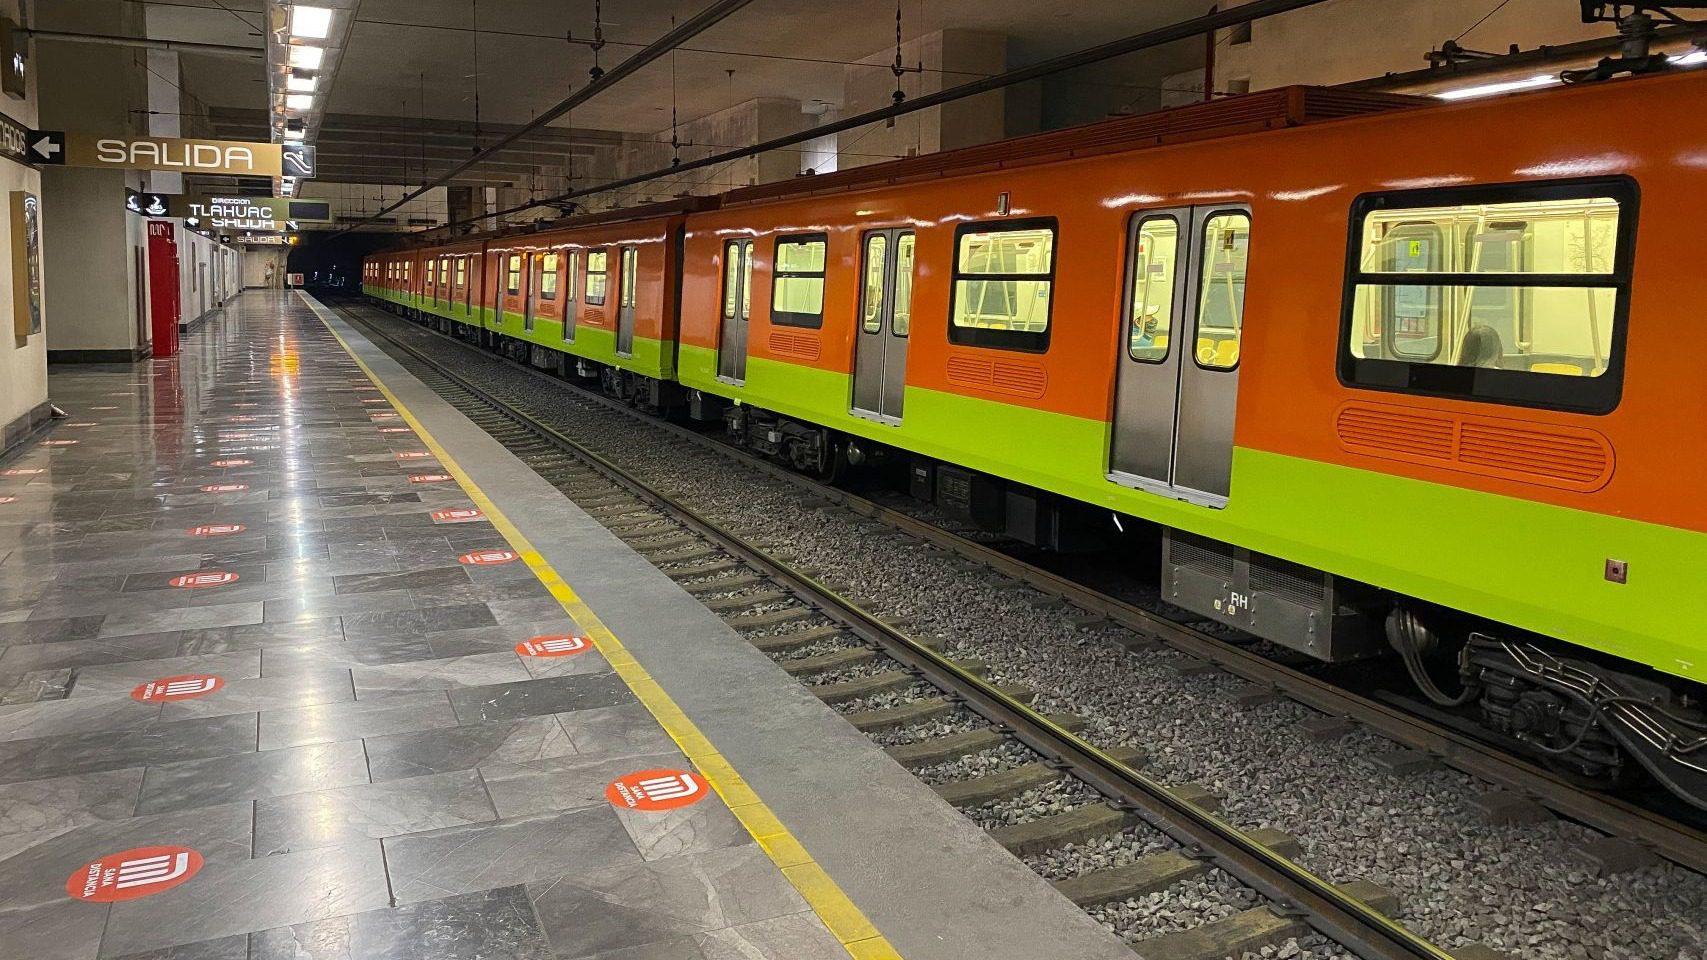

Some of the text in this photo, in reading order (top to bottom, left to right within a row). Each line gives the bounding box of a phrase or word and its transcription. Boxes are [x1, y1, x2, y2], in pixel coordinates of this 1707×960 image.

[96, 139, 253, 170] SALIDA
[189, 203, 273, 218] TLAHUAC
[1231, 591, 1248, 609] RH
[82, 863, 102, 898] DISTANCIA
[101, 868, 116, 887] SANA
